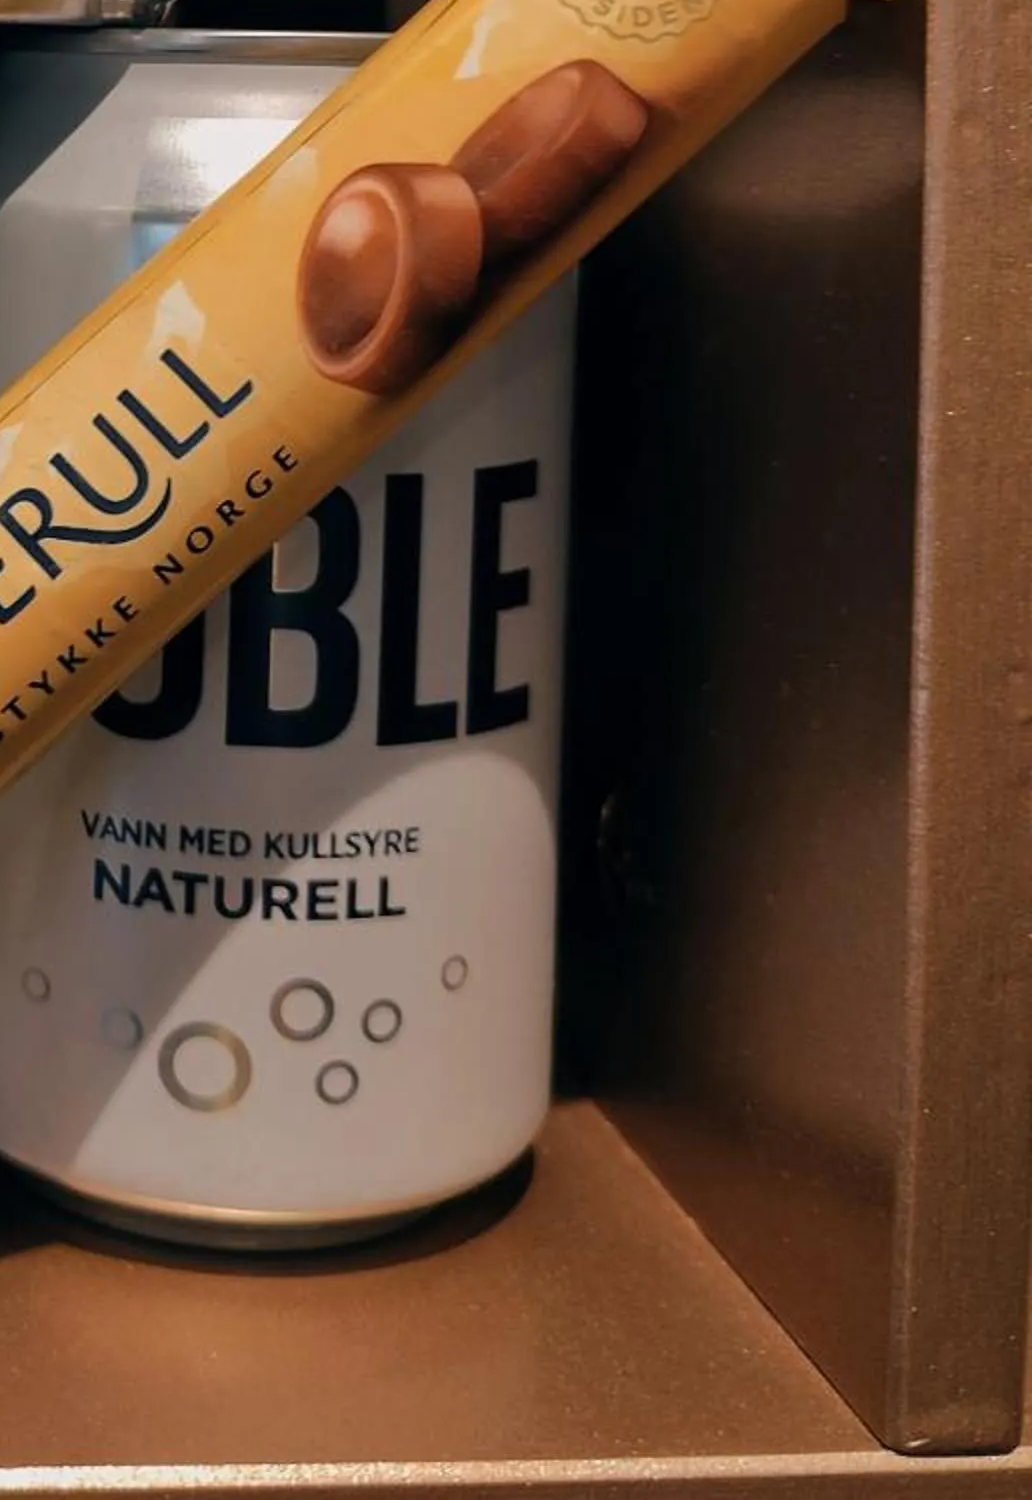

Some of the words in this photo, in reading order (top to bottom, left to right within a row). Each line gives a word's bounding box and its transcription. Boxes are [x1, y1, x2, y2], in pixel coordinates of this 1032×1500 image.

[153, 444, 298, 586] NORGE
[80, 808, 167, 850] VANN
[178, 826, 251, 860] MED
[264, 826, 421, 862] KULLSYRE
[92, 857, 406, 924] NATURELL
